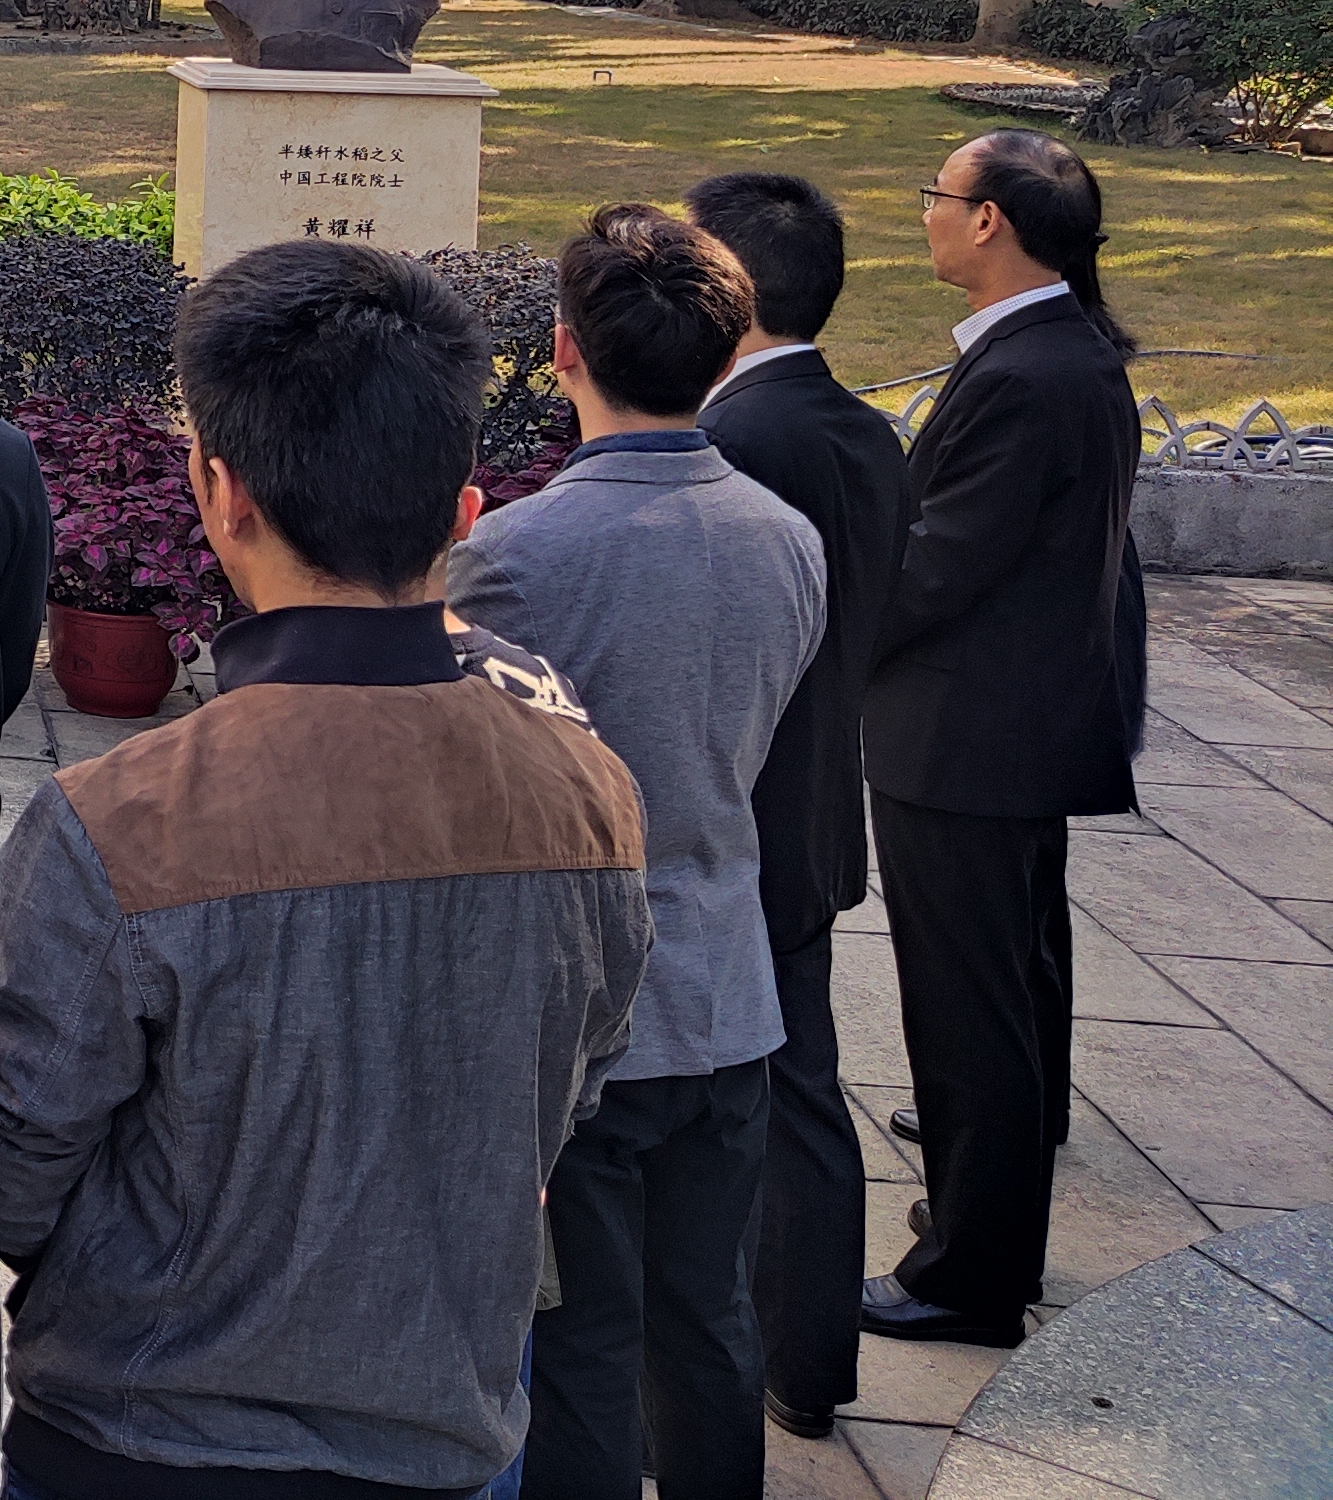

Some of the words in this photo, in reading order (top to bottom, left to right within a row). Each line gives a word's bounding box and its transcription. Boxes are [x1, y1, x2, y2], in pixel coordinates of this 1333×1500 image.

[278, 144, 405, 163] 半矮秆水稻之父
[279, 170, 404, 188] 中国工程院院士
[301, 216, 376, 240] 黄耀祥
